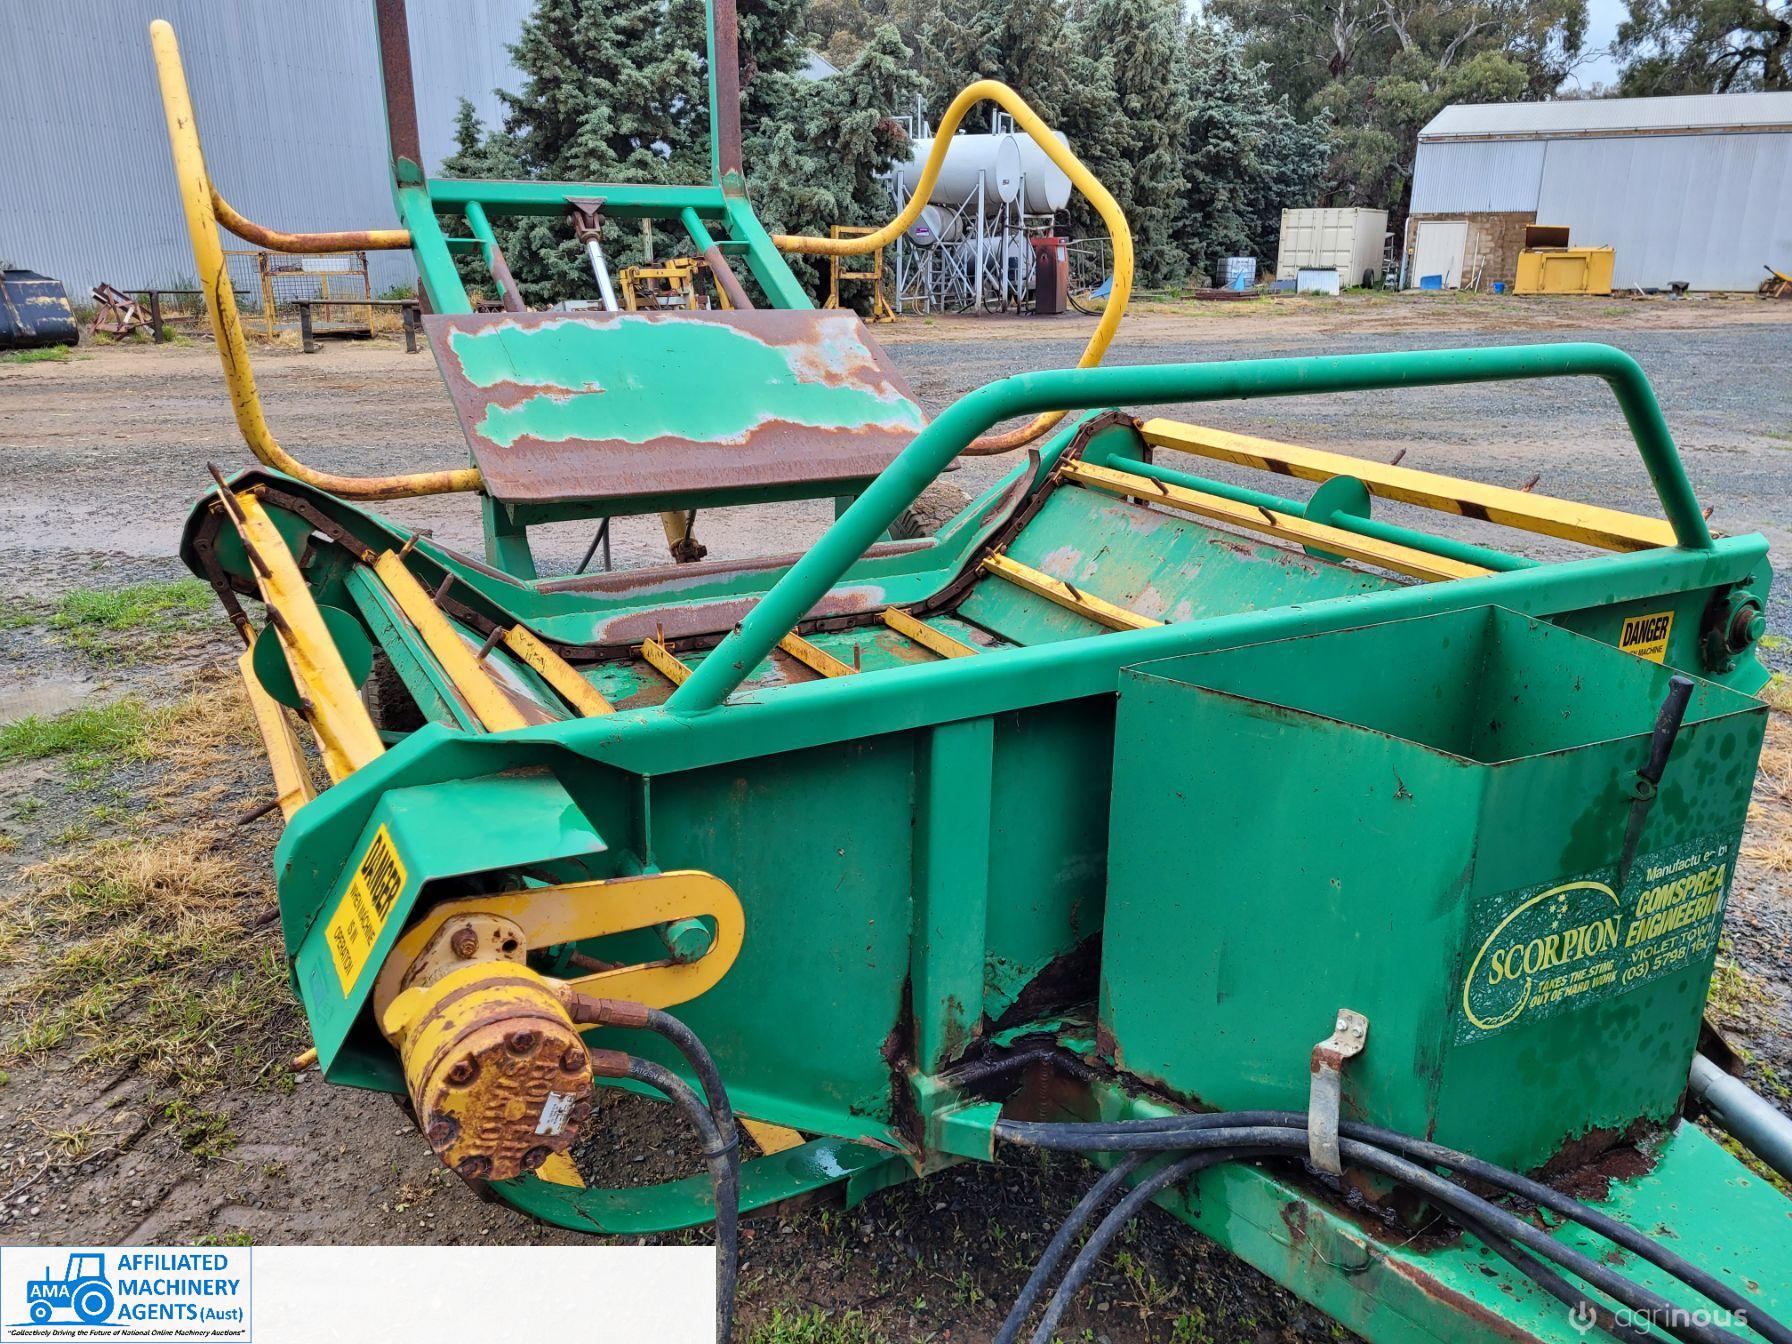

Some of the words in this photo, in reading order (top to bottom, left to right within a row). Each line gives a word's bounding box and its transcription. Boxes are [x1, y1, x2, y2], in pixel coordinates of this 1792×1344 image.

[1623, 616, 1669, 647] DANGER
[1638, 645, 1663, 656] MACHINE
[361, 833, 402, 923] DANGER
[1646, 850, 1715, 882] Manufactue
[350, 881, 362, 910] WHEN
[358, 903, 376, 947] MACHINE
[334, 925, 354, 976] OPERATION
[1489, 915, 1623, 984] SCORPION
[1622, 962, 1649, 985] (03)
[1653, 946, 1686, 971] 5798
[1631, 936, 1678, 963] VIOLET
[1529, 991, 1550, 1009] OUT
[1551, 988, 1564, 1001] OF
[1564, 980, 1590, 997] HARD
[1592, 970, 1618, 988] WORK
[1538, 975, 1567, 993] TAKES
[1570, 968, 1588, 983] THE
[1588, 959, 1615, 976] STING
